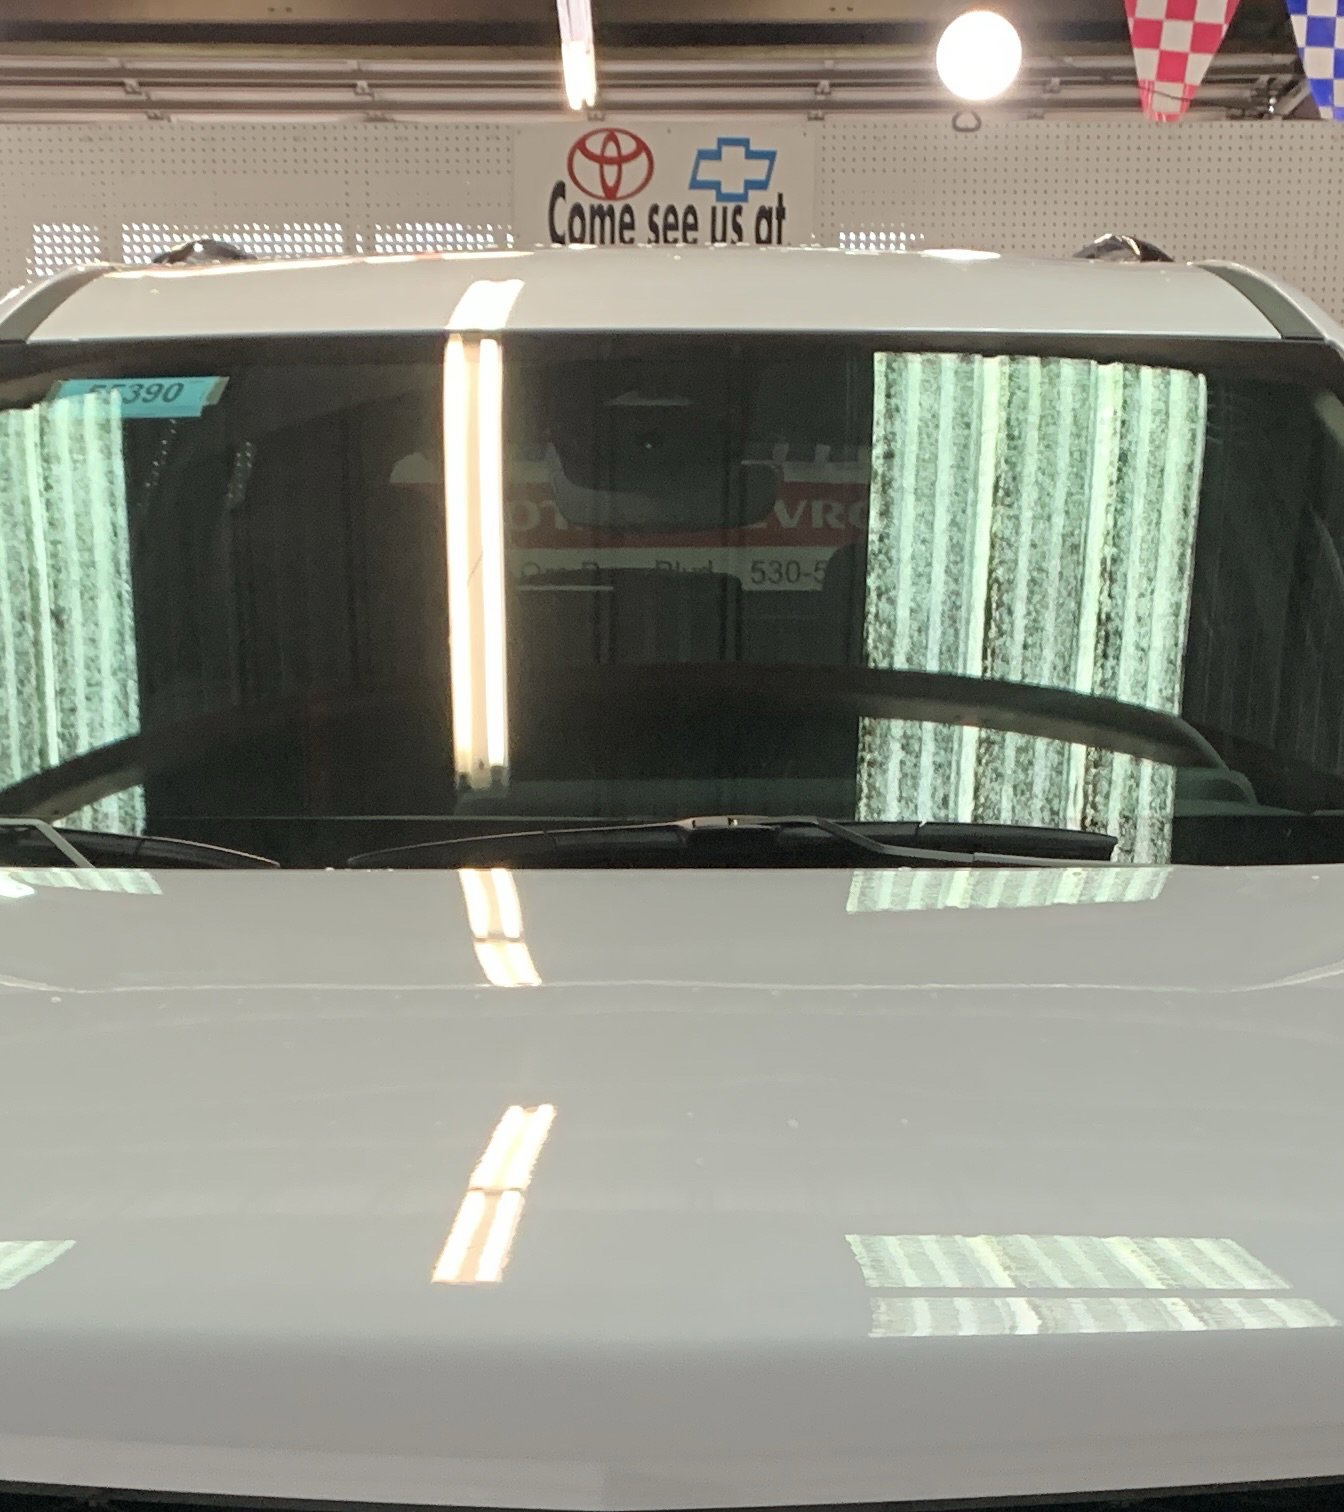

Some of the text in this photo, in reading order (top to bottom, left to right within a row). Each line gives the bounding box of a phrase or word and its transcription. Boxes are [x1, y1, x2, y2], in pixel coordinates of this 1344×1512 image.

[548, 180, 787, 245] Come see us at
